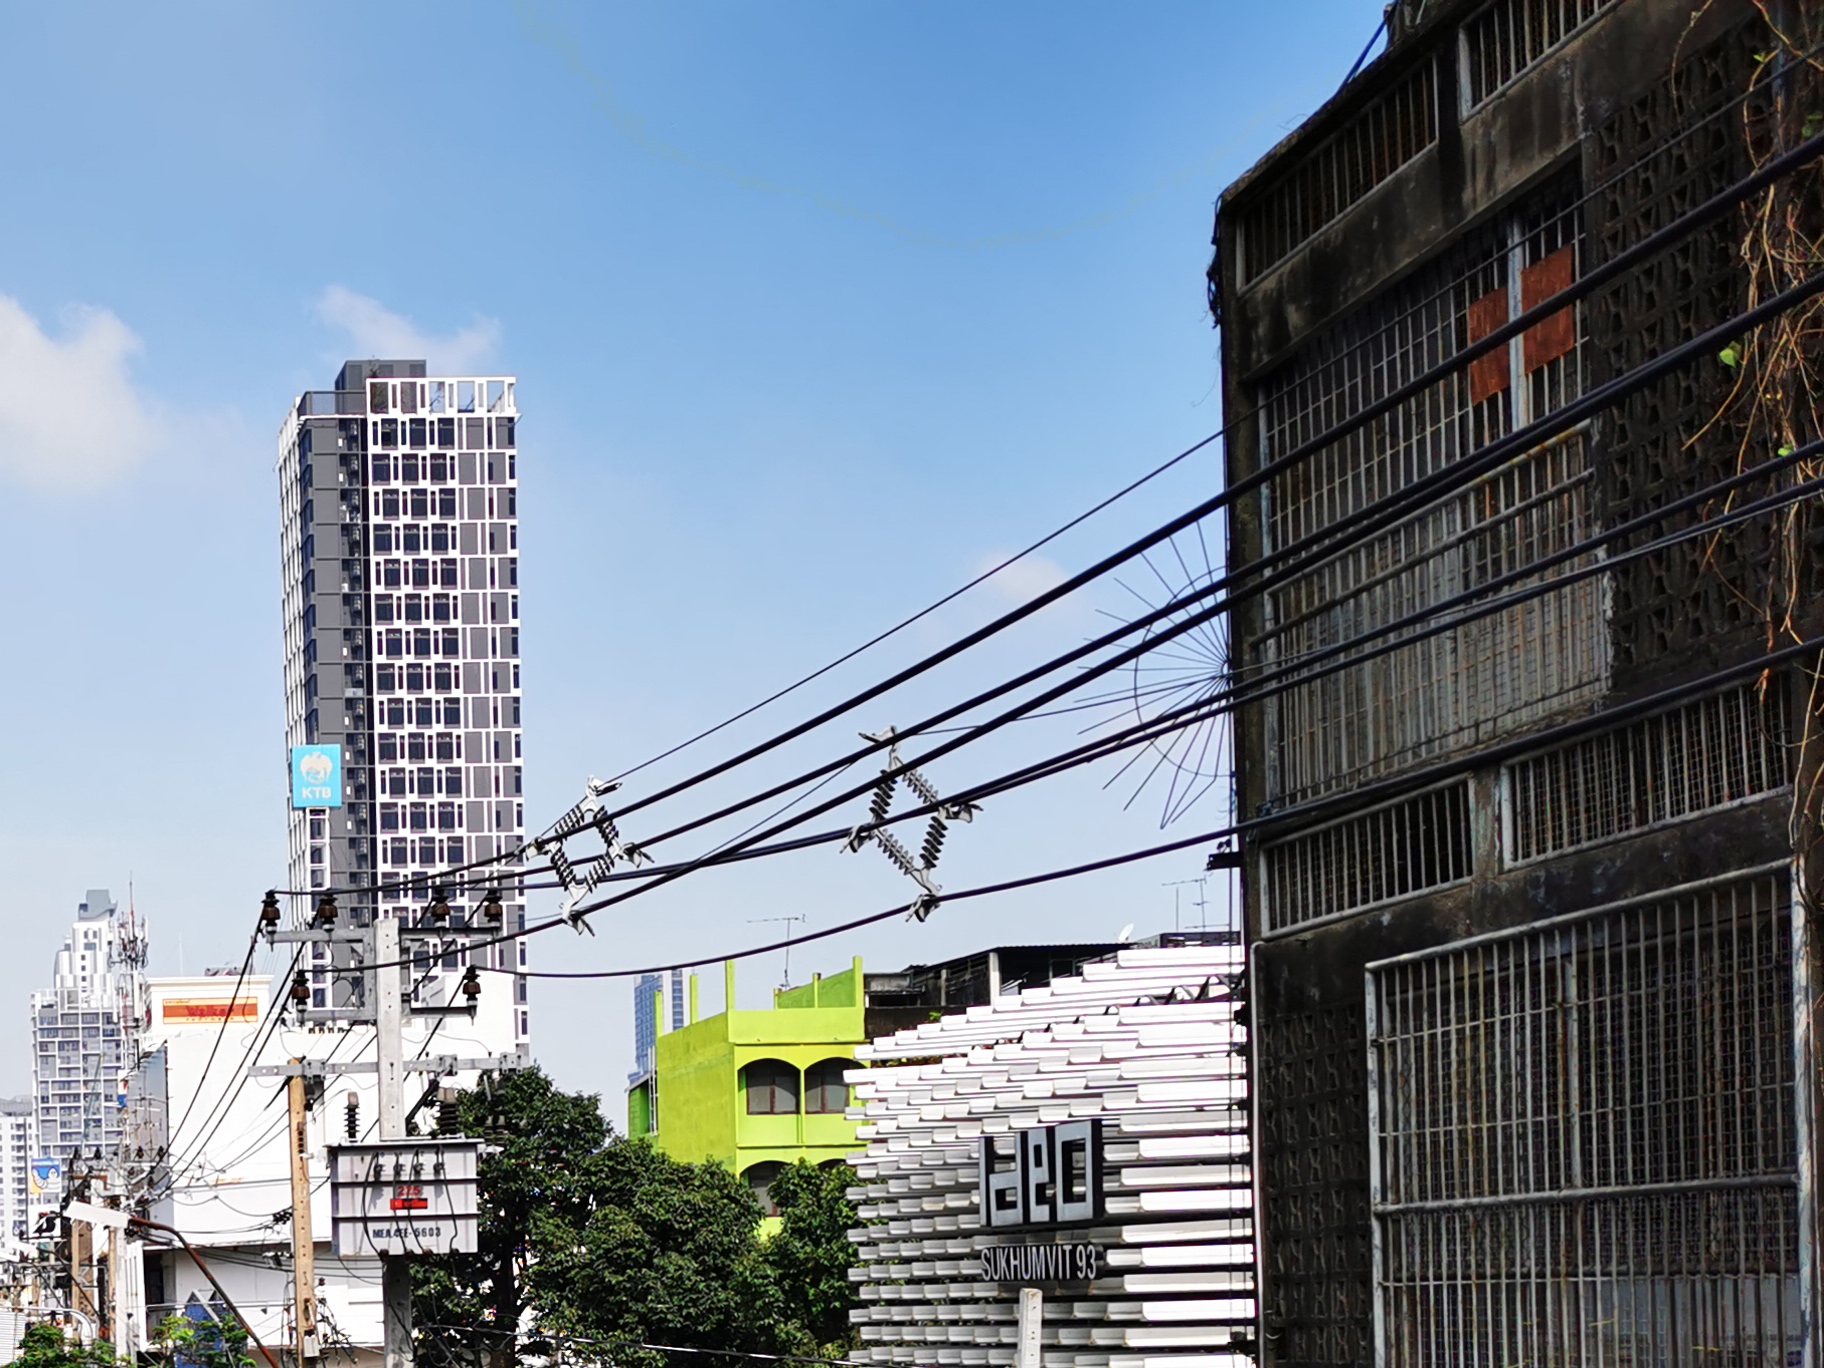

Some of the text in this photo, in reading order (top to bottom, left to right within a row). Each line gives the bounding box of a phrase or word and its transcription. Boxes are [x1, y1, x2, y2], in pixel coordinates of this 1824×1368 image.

[302, 786, 332, 800] KTB
[981, 1244, 1096, 1281] SUKHUMVIT 93
